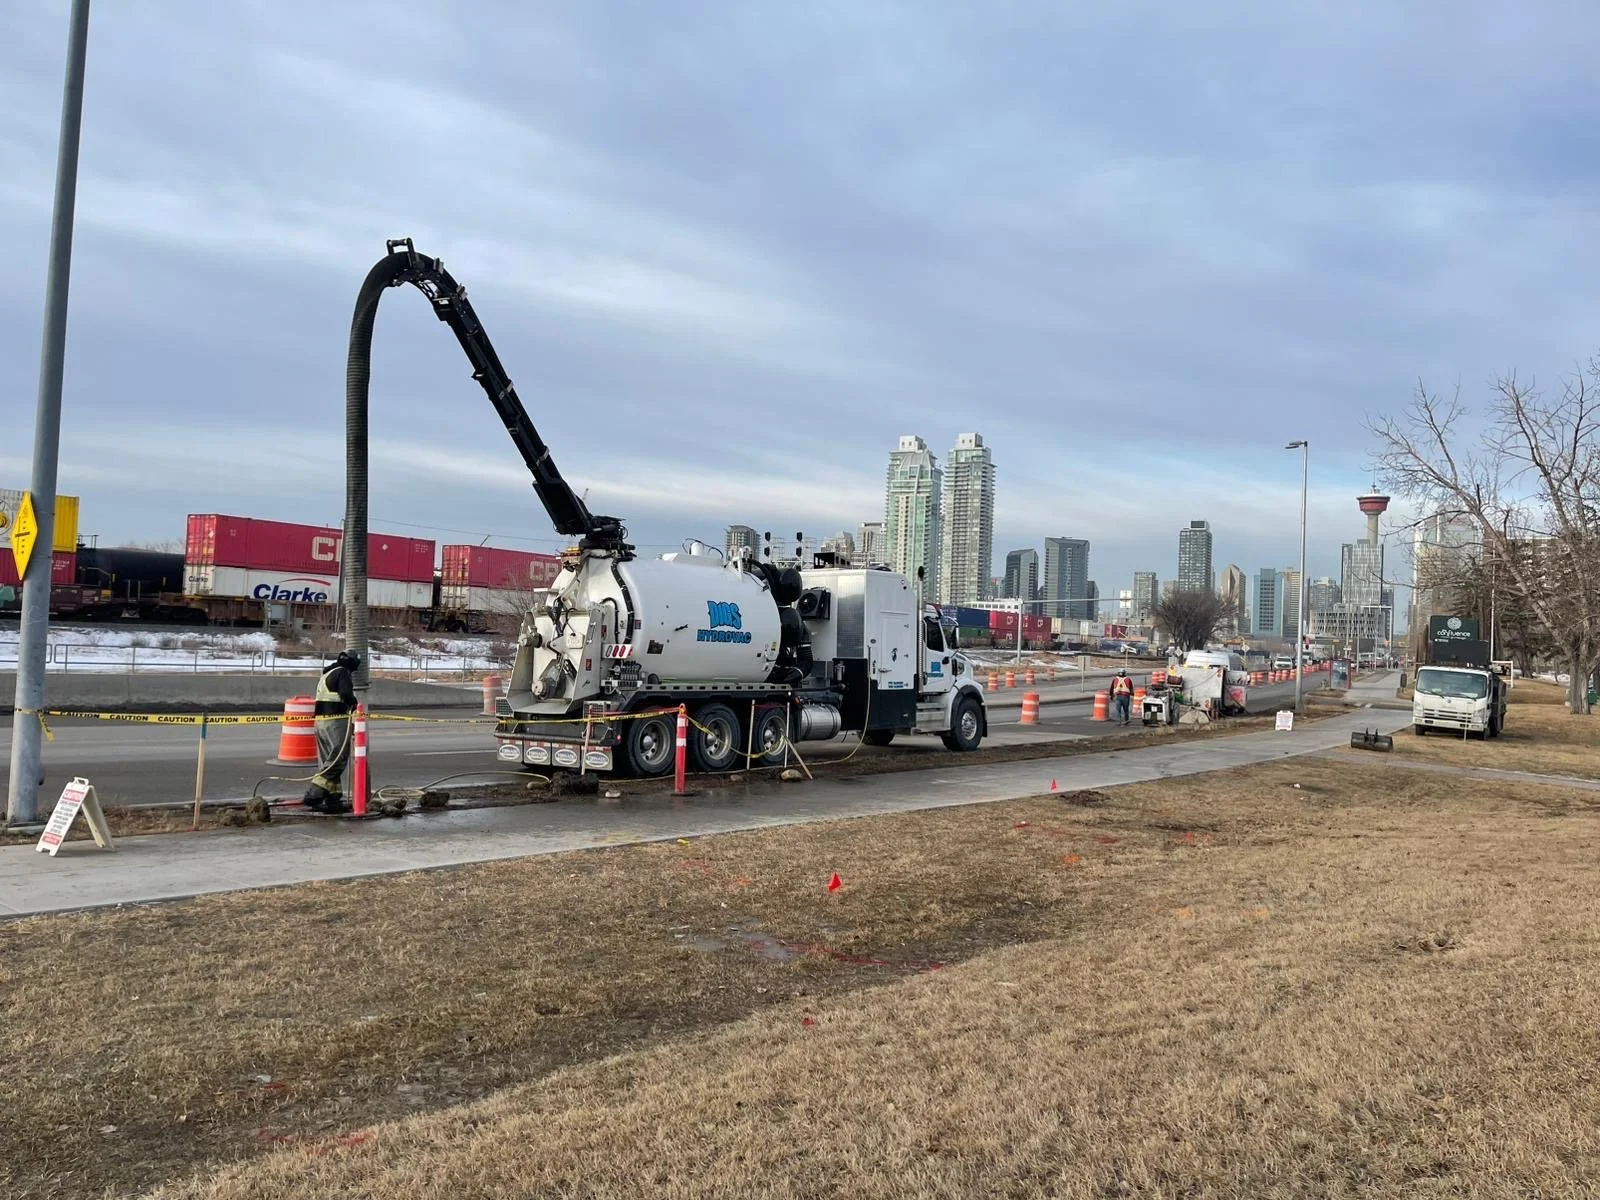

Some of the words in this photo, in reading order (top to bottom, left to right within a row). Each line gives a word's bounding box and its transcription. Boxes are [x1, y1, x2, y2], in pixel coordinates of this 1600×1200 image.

[253, 583, 328, 603] Clarke
[707, 600, 742, 630] DIGS
[697, 629, 752, 644] HYDROVAC
